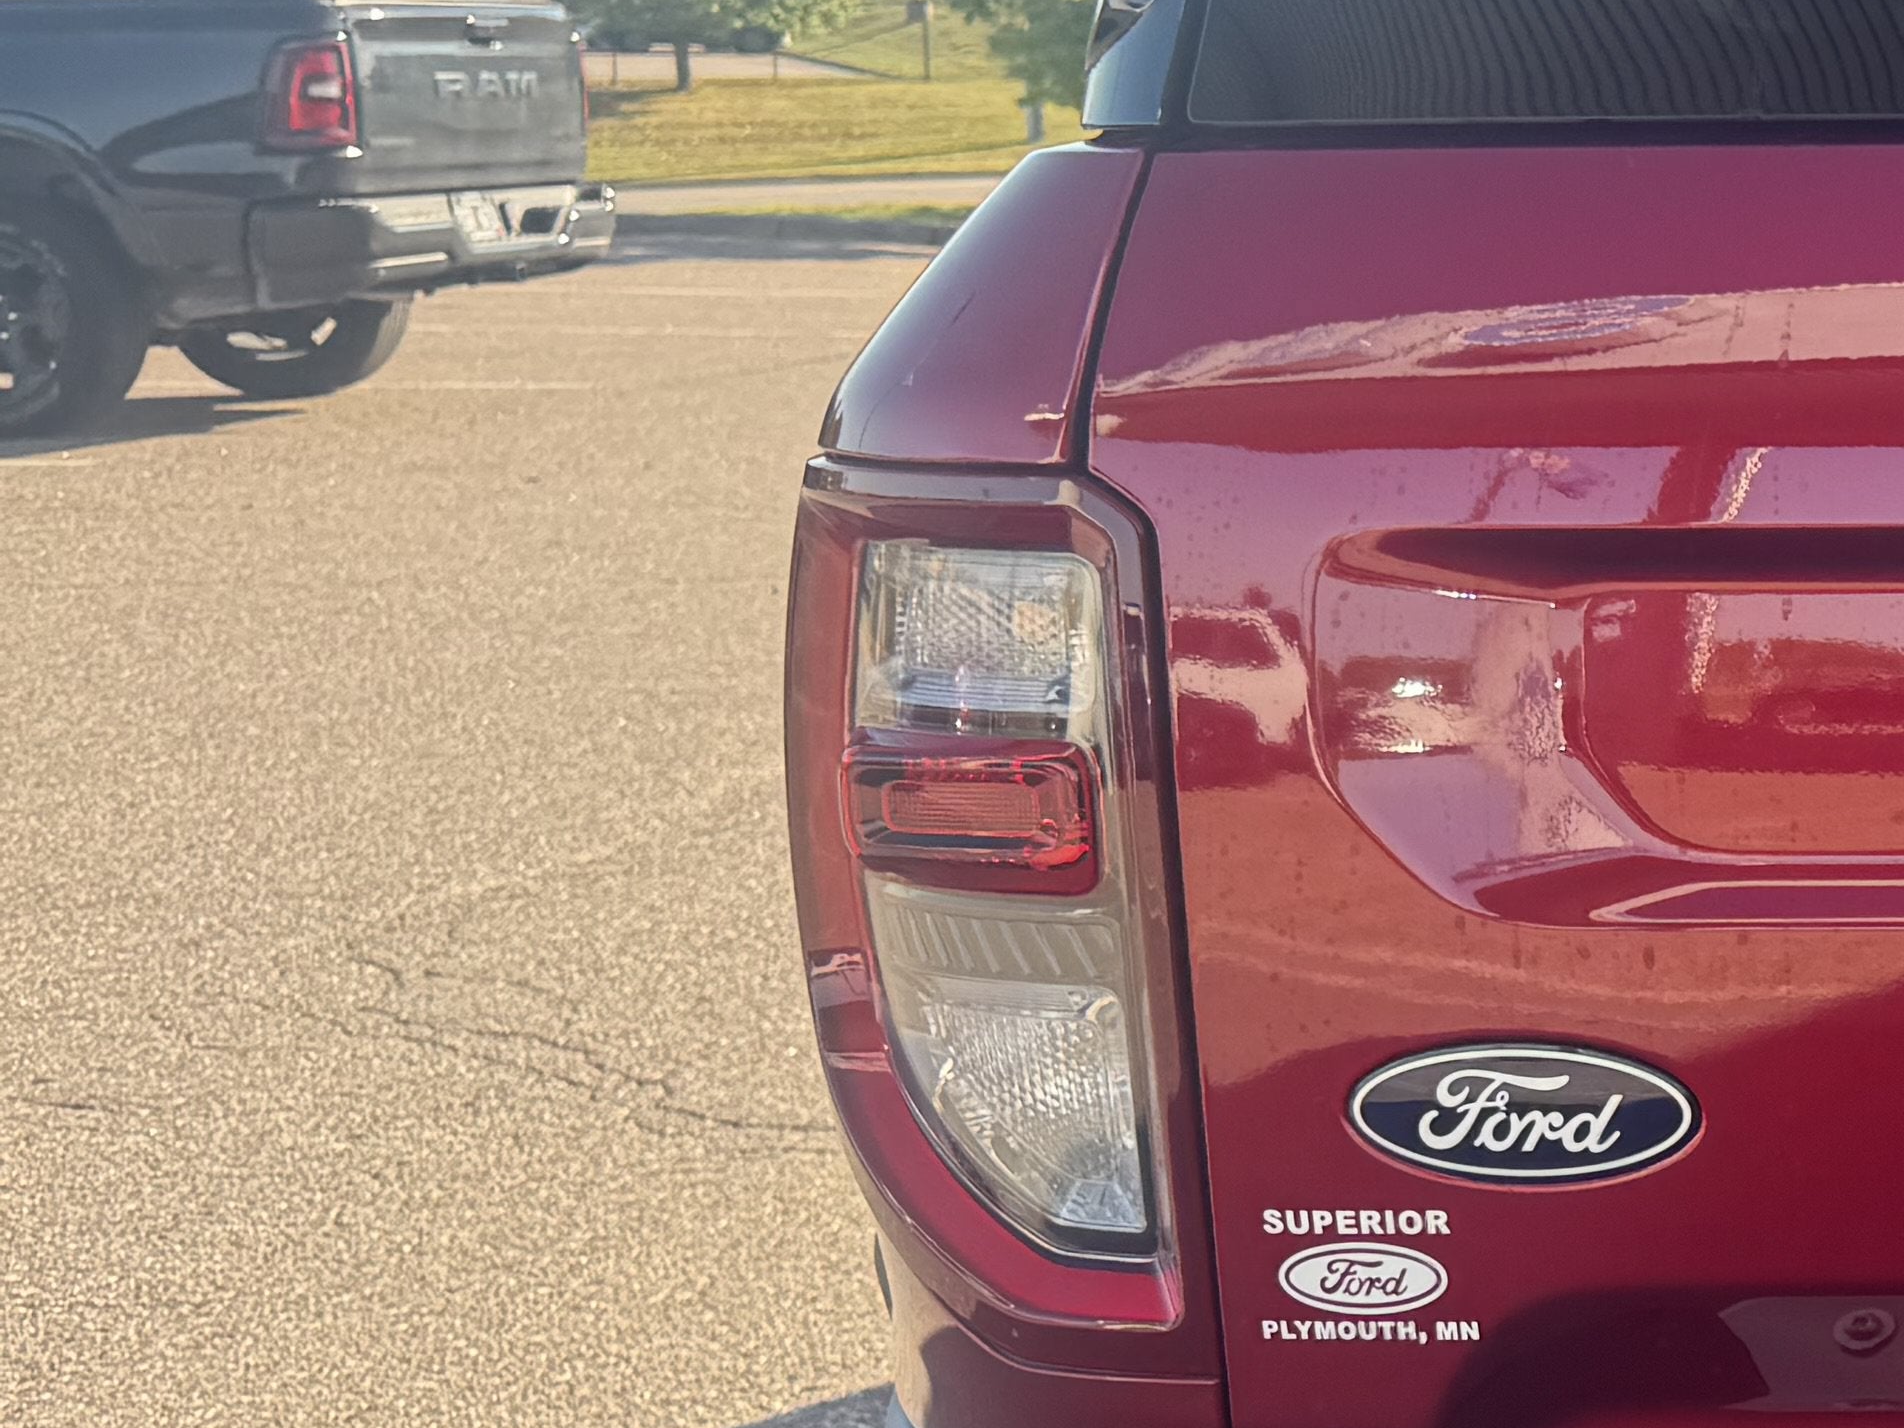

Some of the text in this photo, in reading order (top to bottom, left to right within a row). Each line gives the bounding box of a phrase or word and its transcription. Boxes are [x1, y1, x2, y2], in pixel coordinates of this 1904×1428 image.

[434, 70, 538, 97] RAM
[1418, 1069, 1624, 1154] Ford
[1262, 1209, 1451, 1236] SUPERIOR
[1319, 1258, 1408, 1298] Ford
[1262, 1320, 1481, 1344] PLYMOUTH, MN
